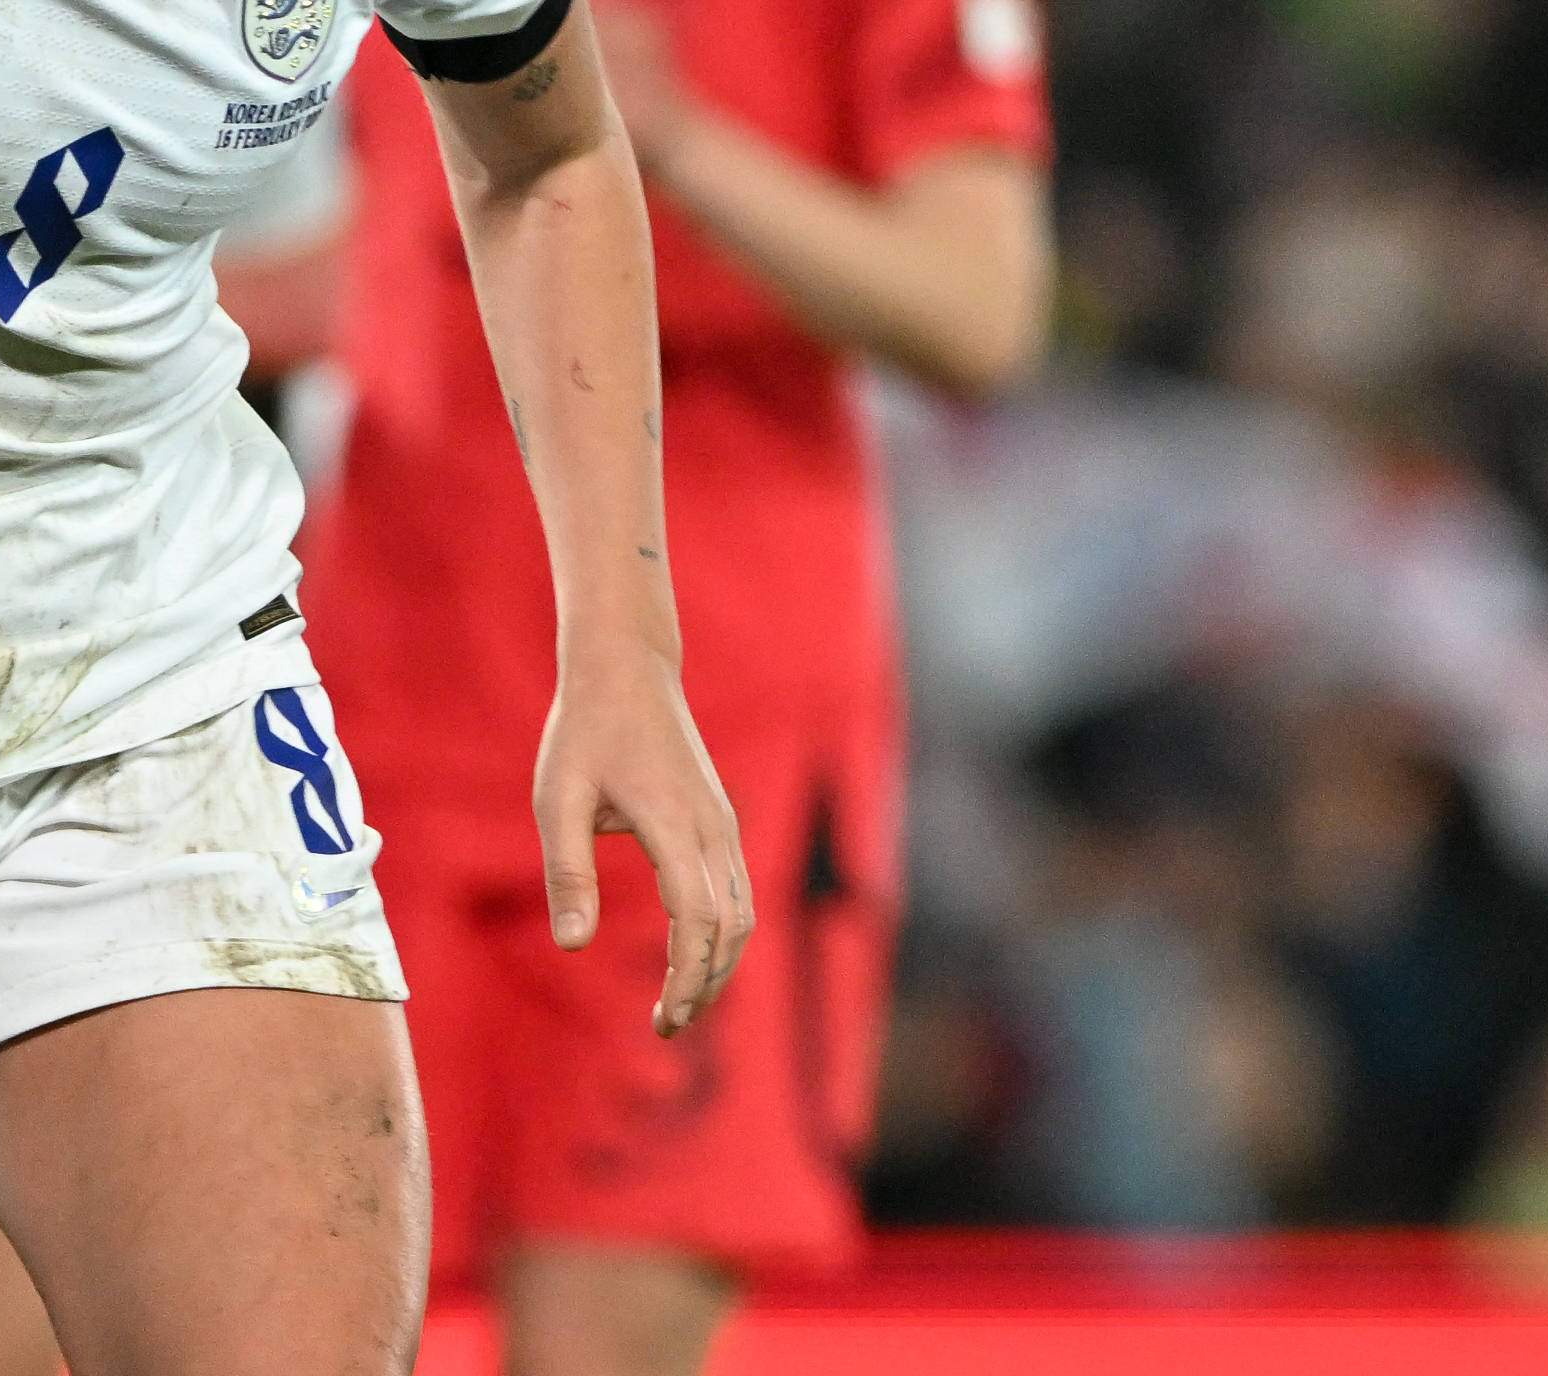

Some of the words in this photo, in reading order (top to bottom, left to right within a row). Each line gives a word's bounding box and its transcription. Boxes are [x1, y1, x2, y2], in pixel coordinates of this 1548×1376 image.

[223, 102, 278, 124] KOREA
[215, 129, 232, 149] 16
[254, 686, 354, 855] 8
